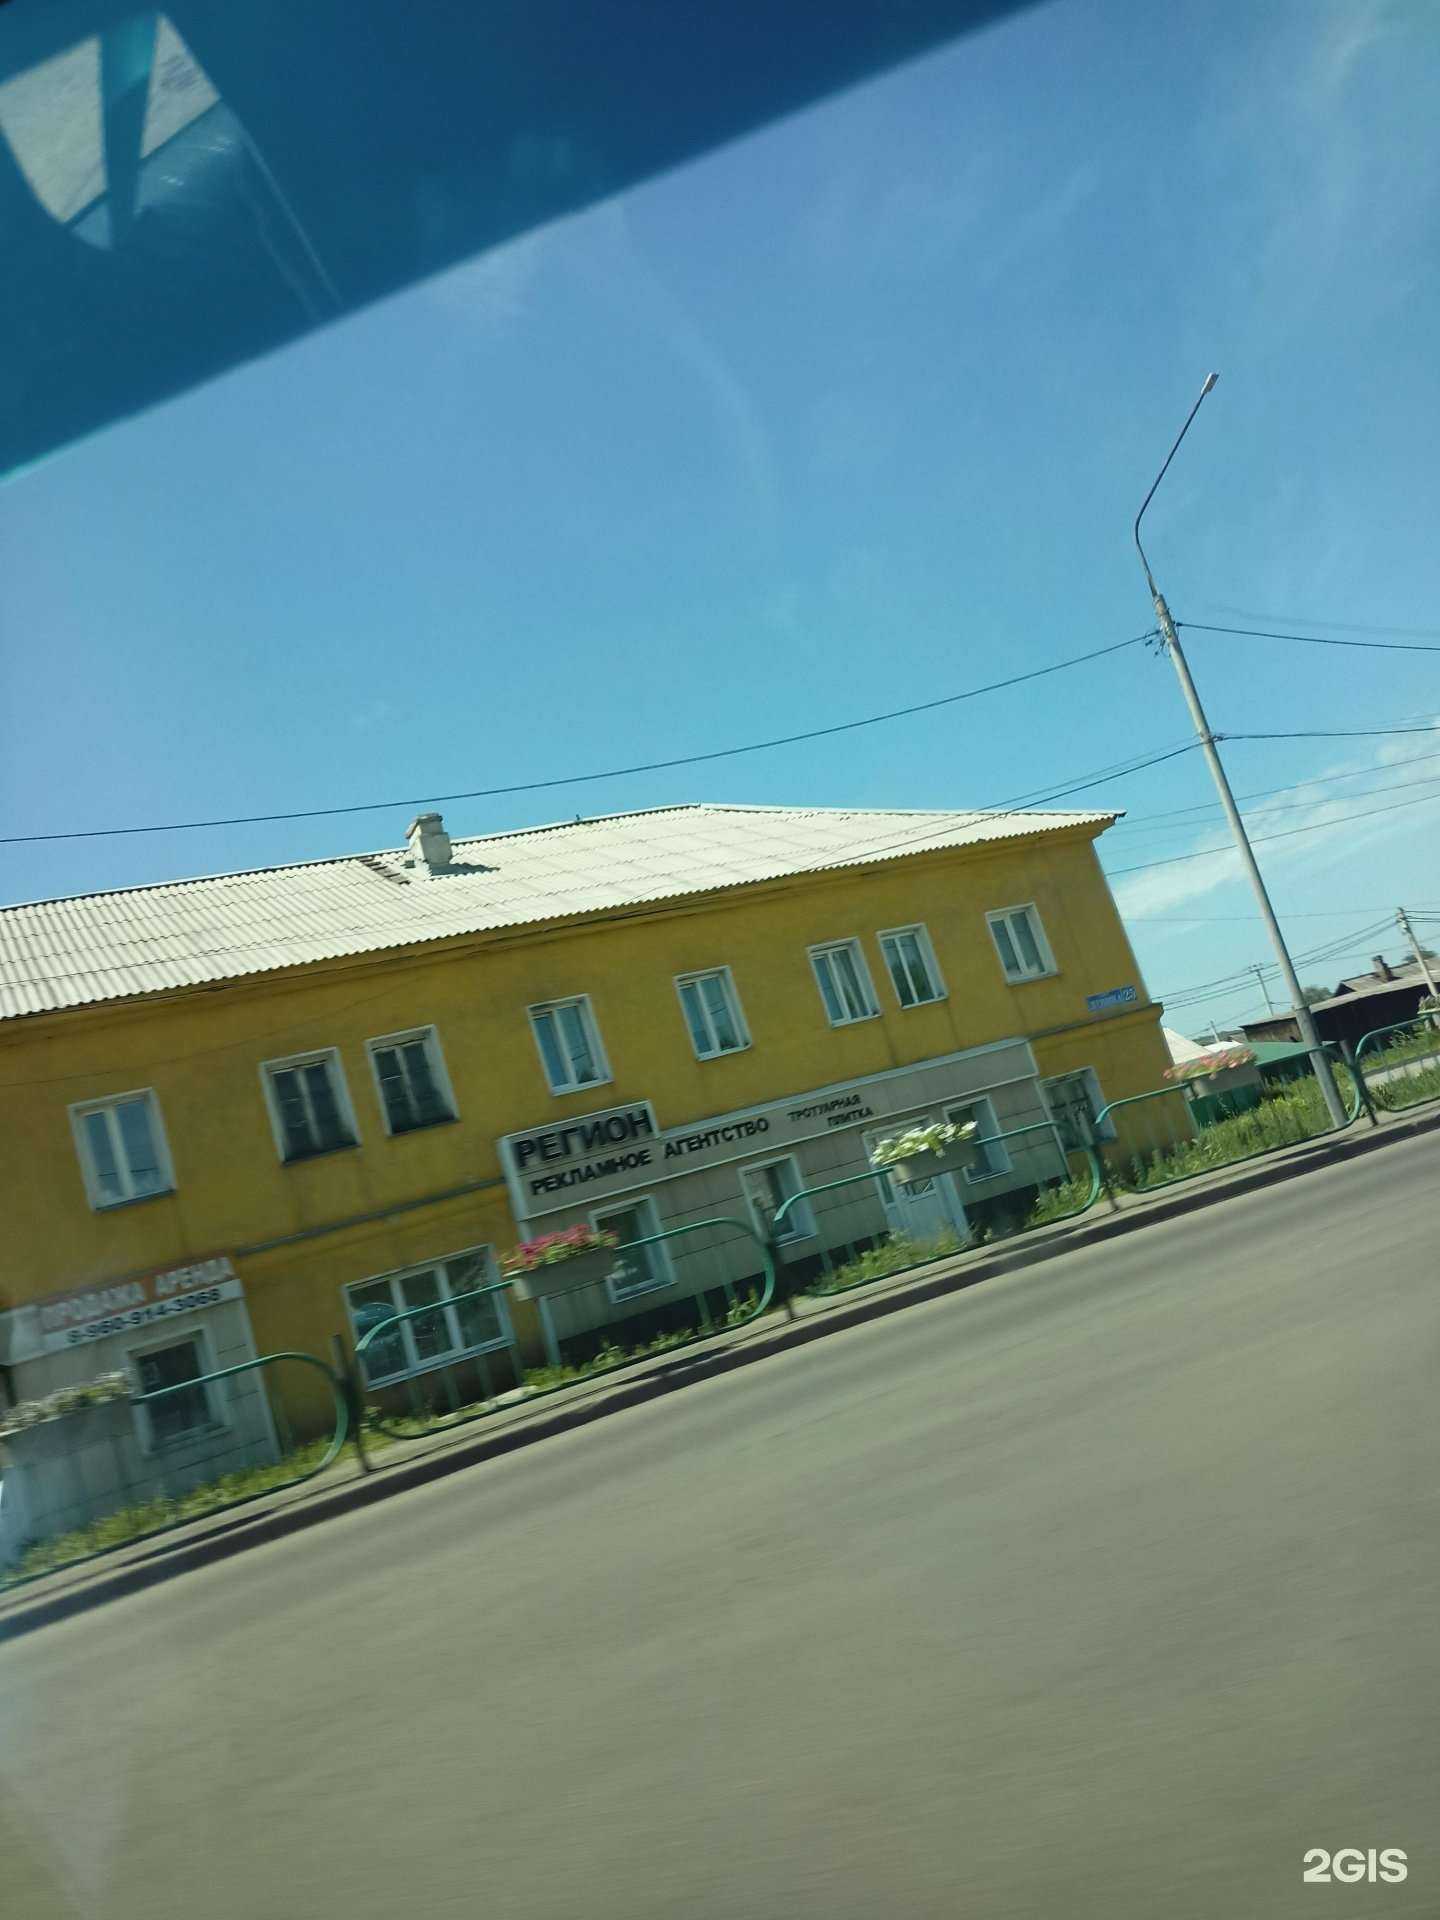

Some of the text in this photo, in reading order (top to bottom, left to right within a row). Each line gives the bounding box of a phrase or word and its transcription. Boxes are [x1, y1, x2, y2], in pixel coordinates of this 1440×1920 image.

[515, 1108, 653, 1169] РЕГИОН
[531, 1117, 770, 1196] РЕКЛАМНОЕ АГЕНТСТВО
